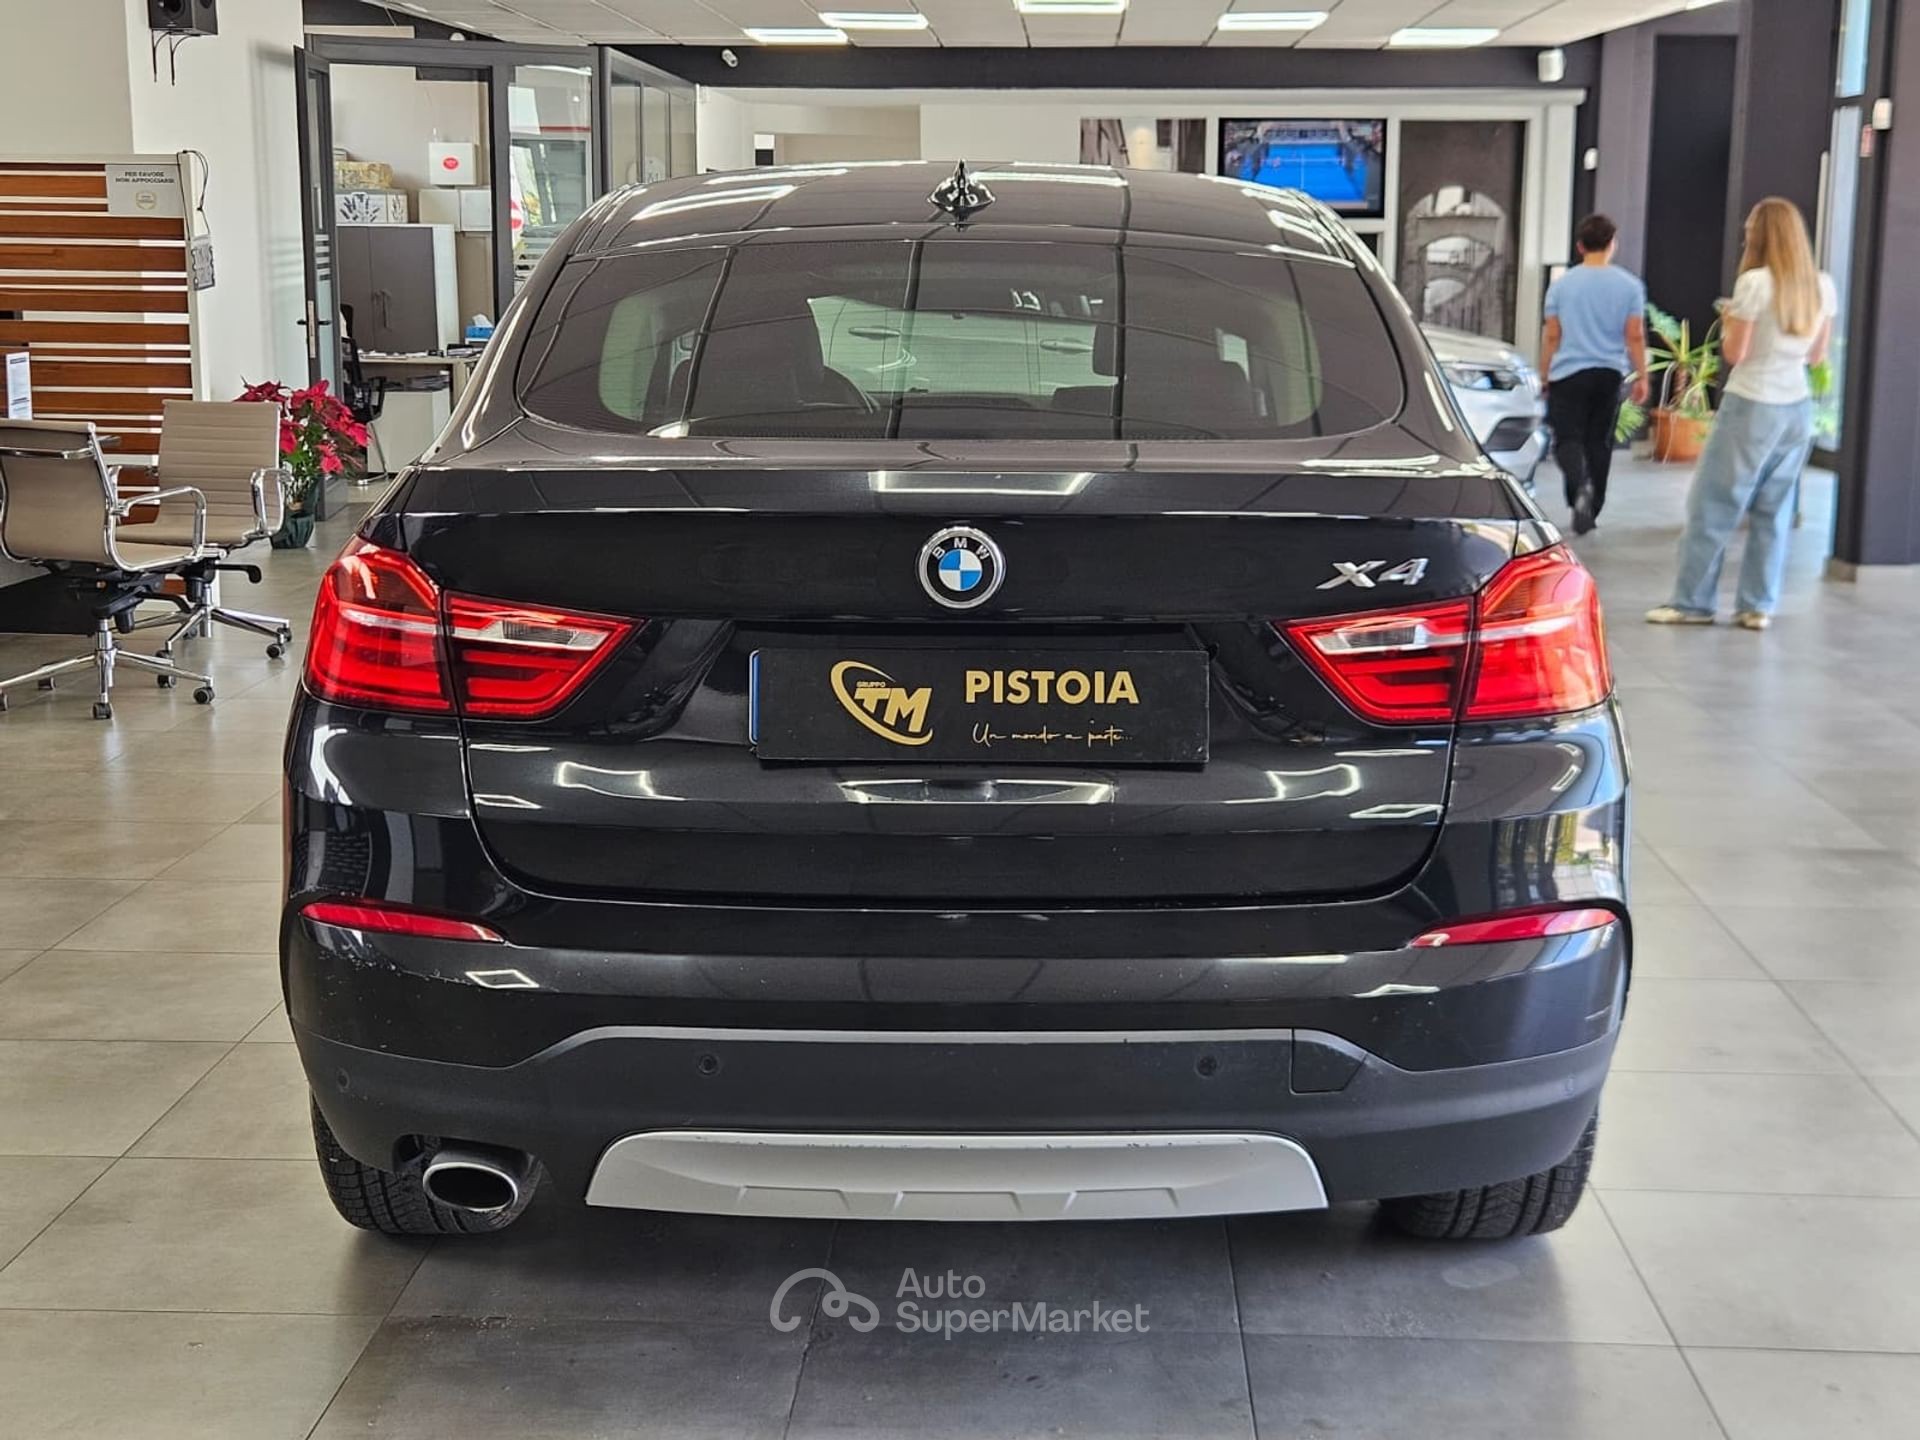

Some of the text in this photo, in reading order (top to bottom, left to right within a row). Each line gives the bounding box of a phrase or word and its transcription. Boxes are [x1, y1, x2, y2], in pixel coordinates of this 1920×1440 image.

[932, 537, 990, 560] BMW
[1315, 558, 1430, 590] X4
[965, 669, 1141, 705] PISTOIA
[853, 687, 933, 733] TM
[972, 722, 1007, 748] Un
[1011, 725, 1061, 744] mondo
